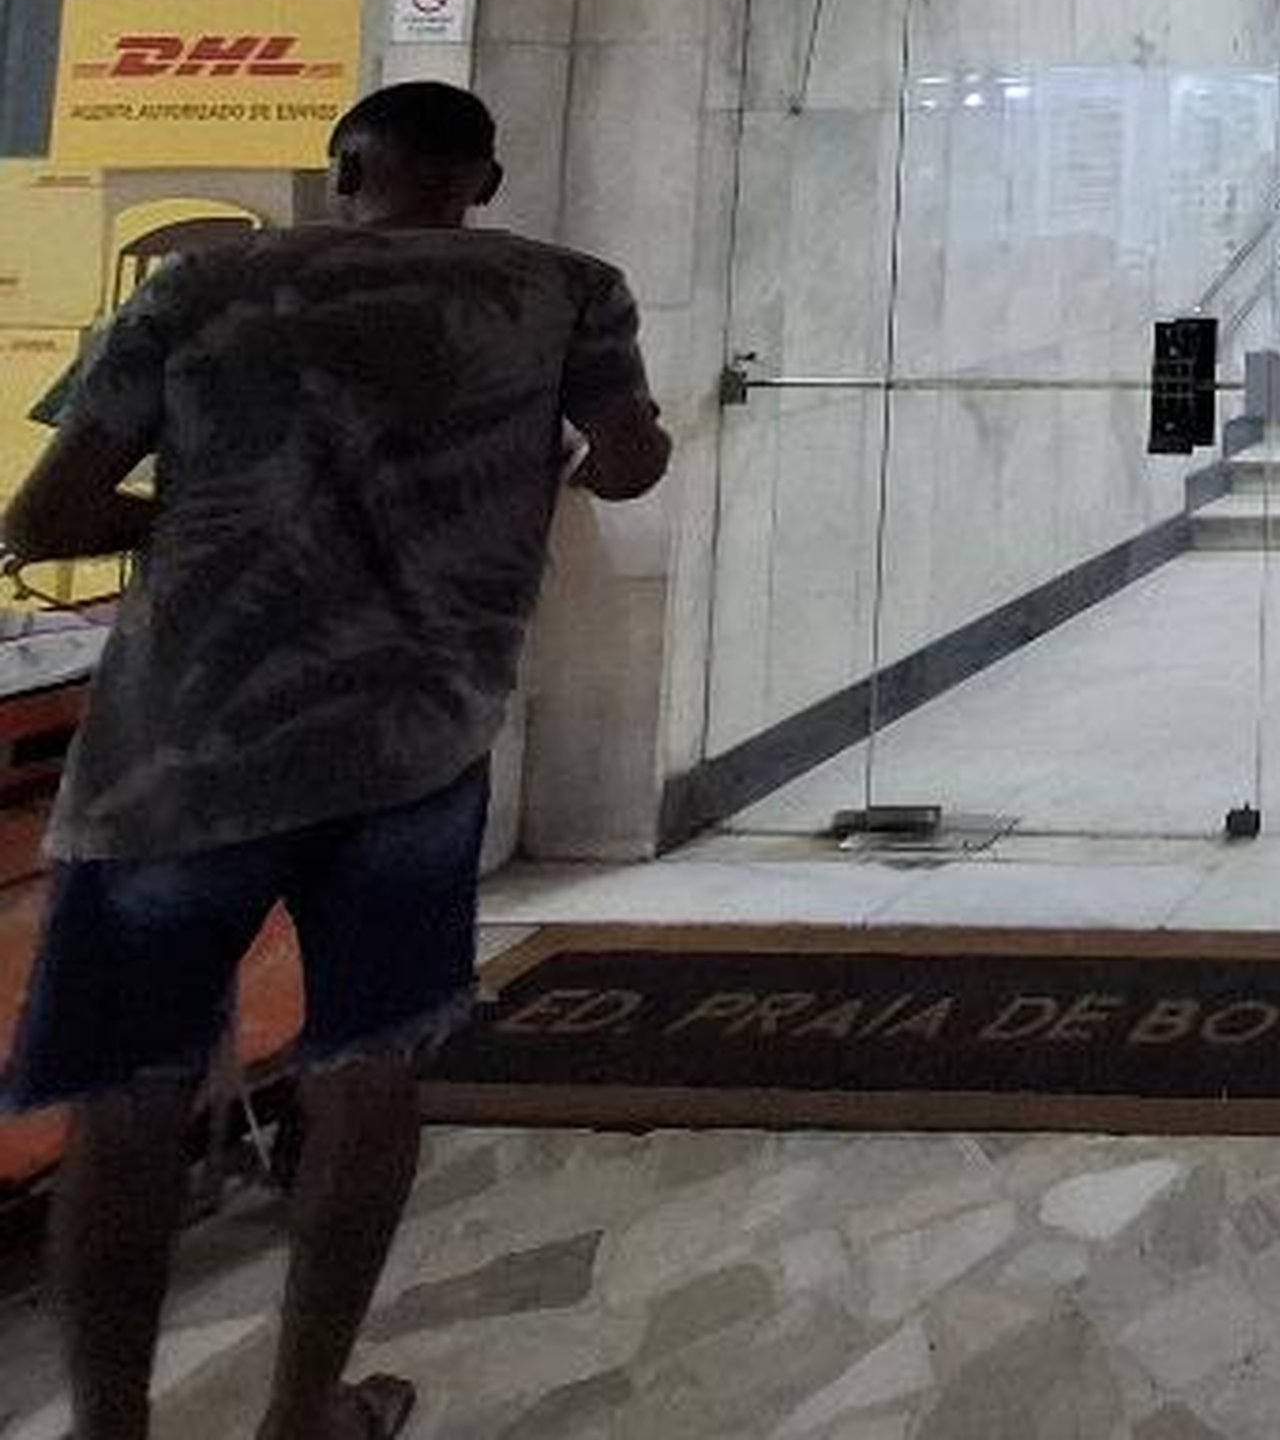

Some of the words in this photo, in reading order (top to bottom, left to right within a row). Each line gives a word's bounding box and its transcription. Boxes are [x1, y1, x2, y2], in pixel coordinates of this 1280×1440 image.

[109, 35, 305, 78] DHL
[665, 992, 958, 1040] PRAIA
[979, 994, 1122, 1042] DE
